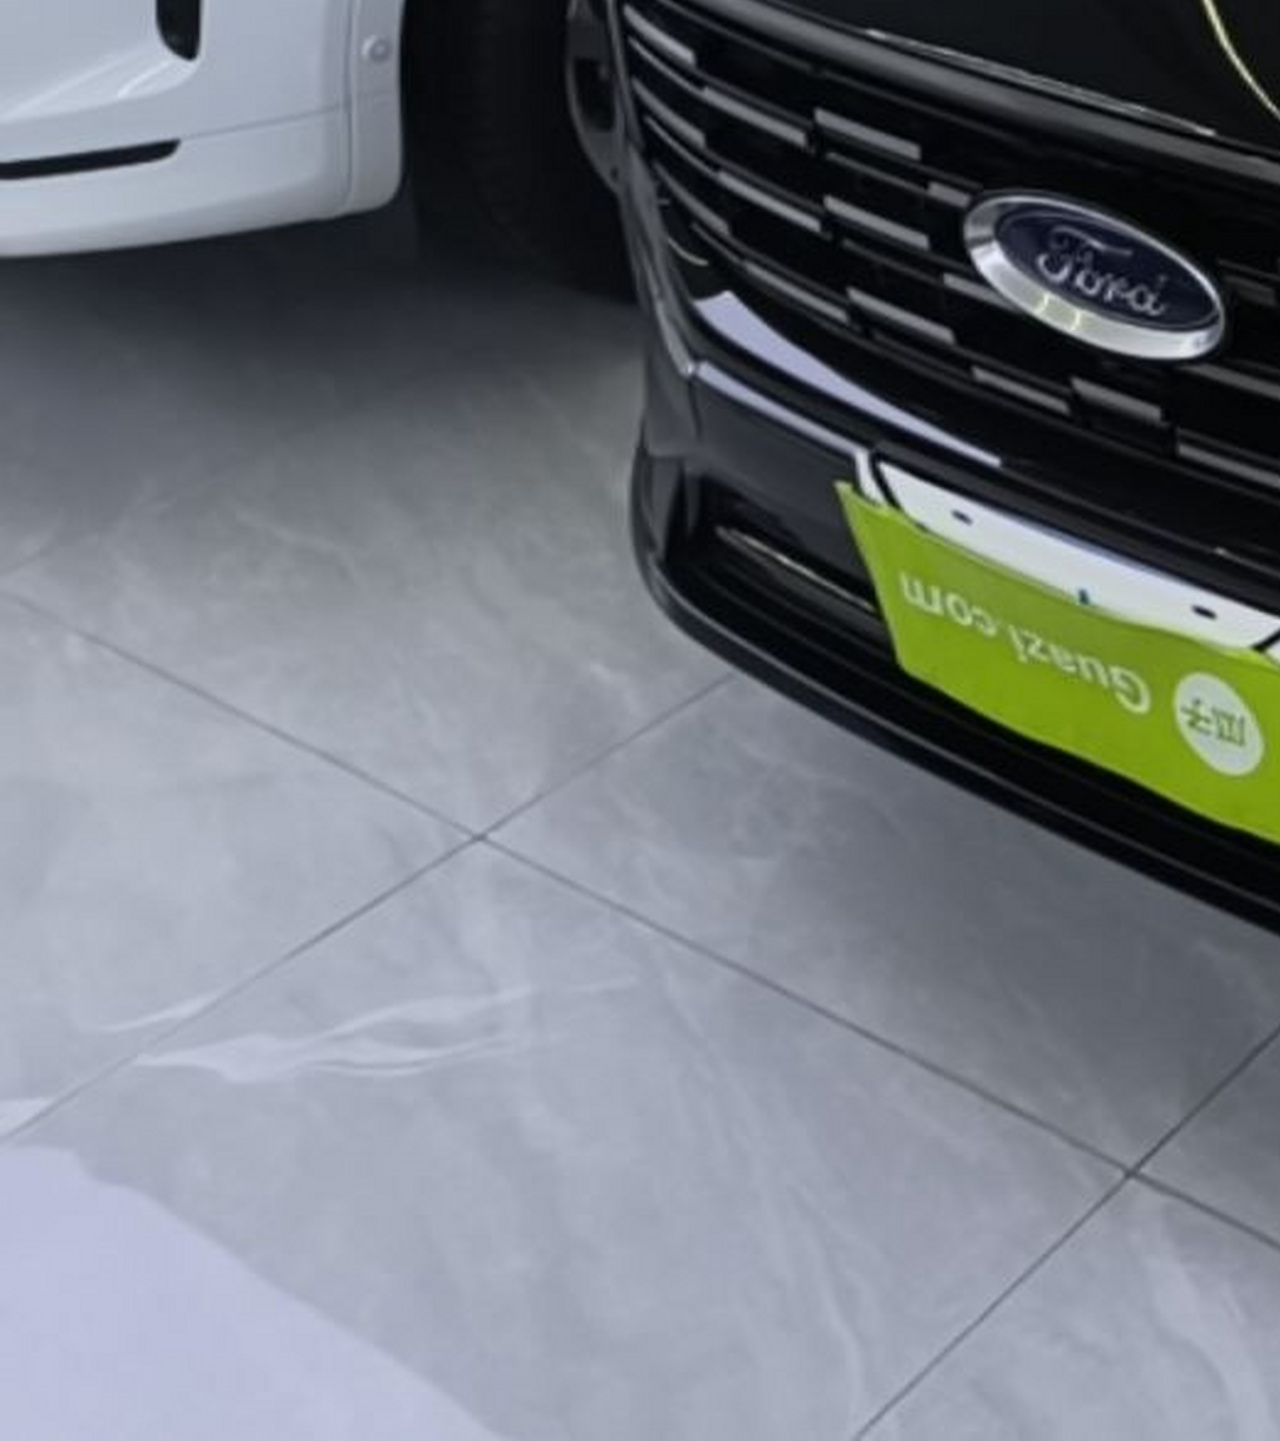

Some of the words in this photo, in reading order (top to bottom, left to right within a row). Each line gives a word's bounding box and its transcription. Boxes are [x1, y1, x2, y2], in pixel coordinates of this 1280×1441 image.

[1035, 224, 1167, 317] Ford
[898, 572, 1152, 717] Guazi.com
[1180, 699, 1248, 747] 瓜子
